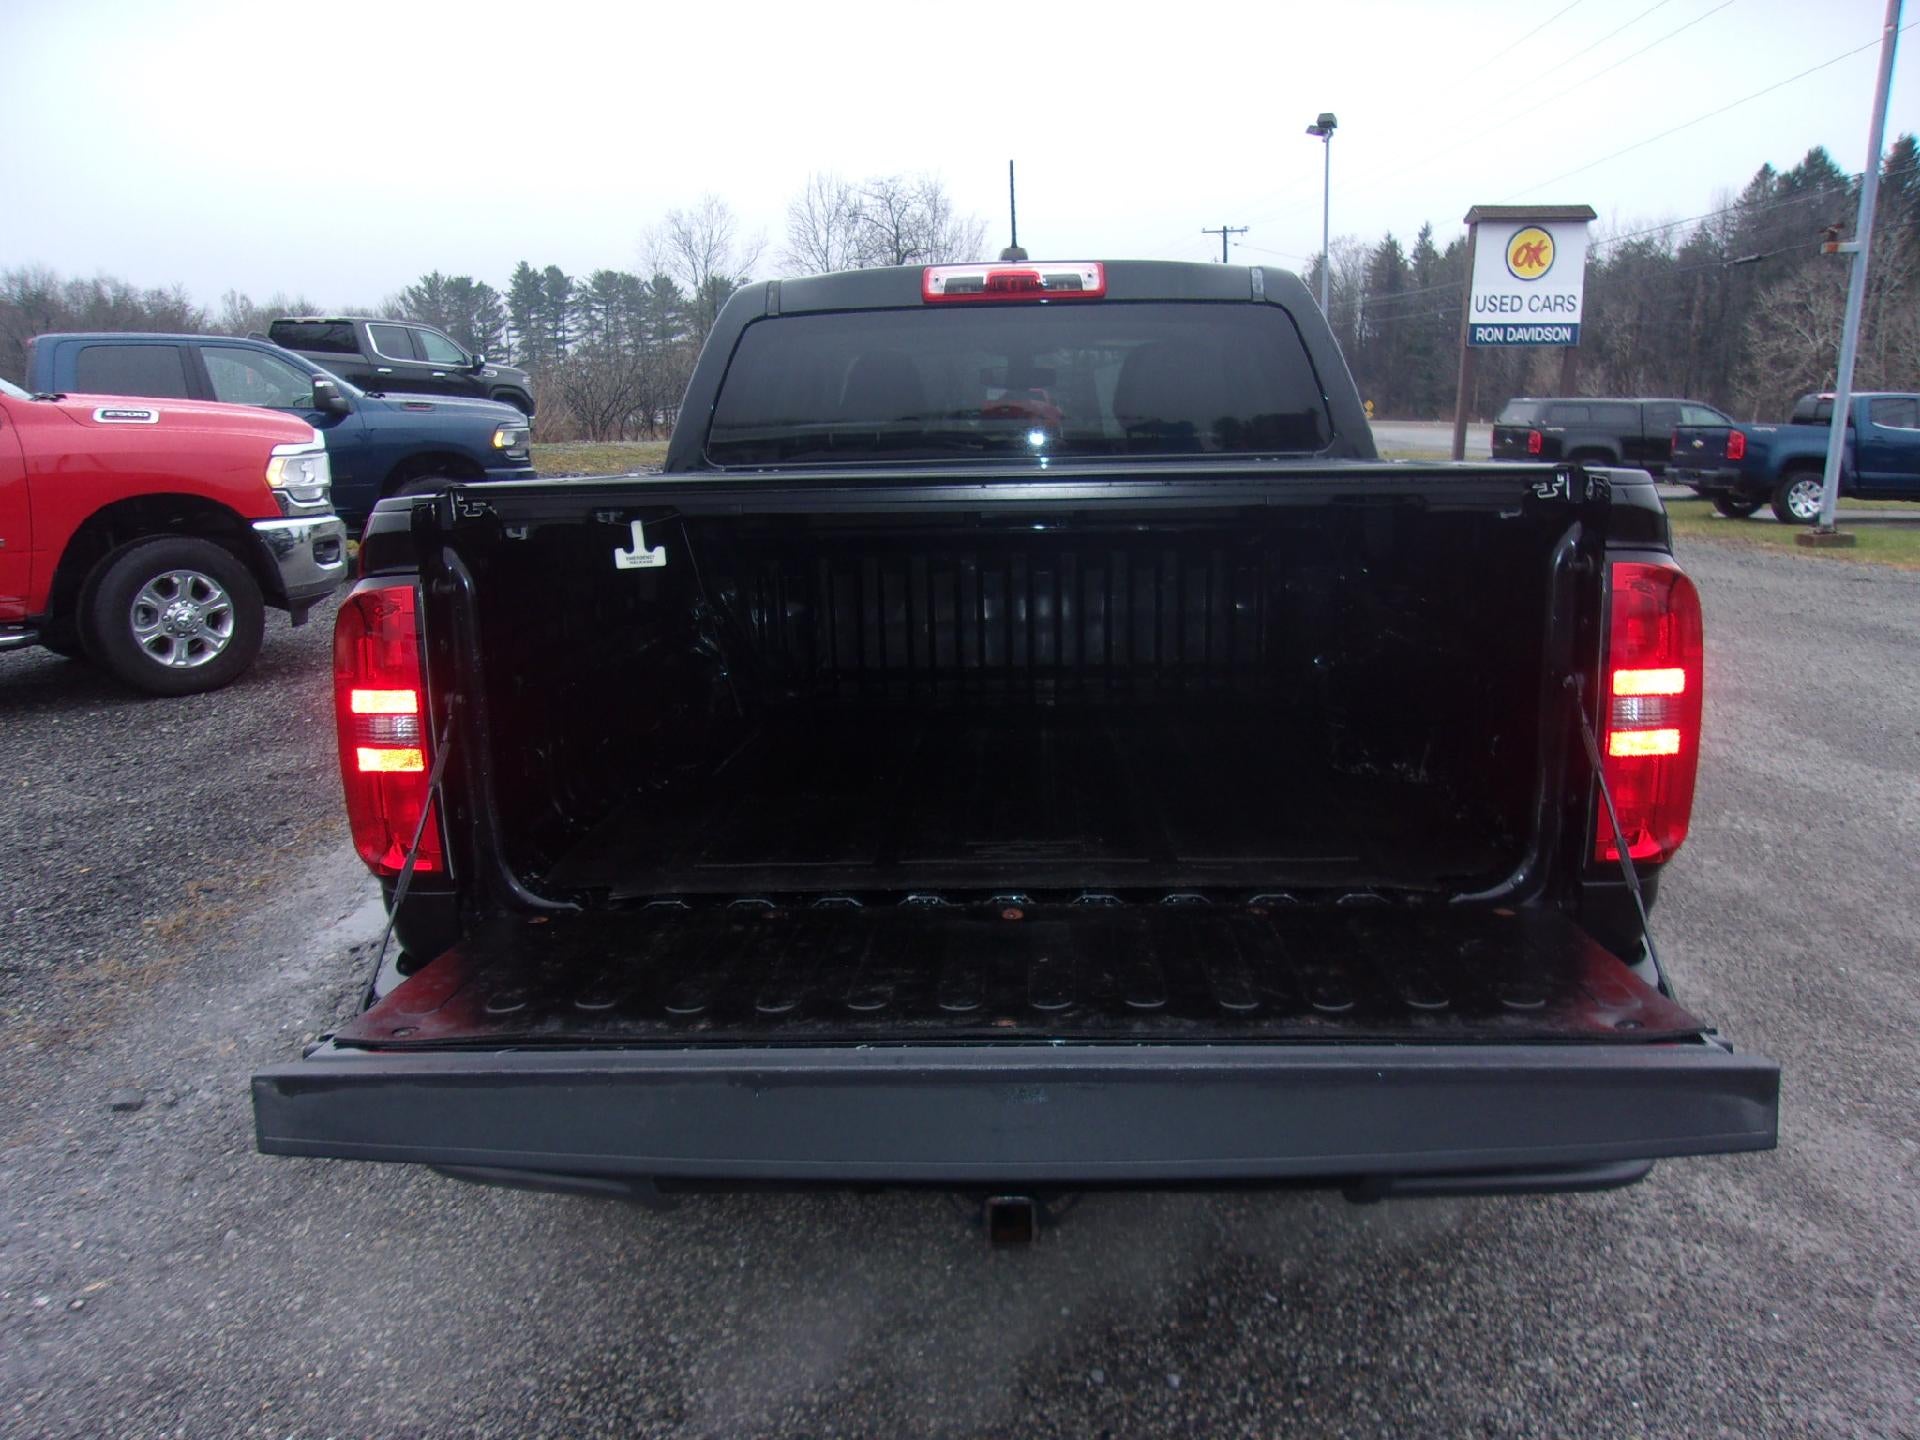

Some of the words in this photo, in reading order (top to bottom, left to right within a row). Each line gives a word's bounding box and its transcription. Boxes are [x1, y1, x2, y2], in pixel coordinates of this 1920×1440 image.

[1512, 240, 1548, 269] OK
[1475, 294, 1523, 313] USED
[1528, 294, 1577, 313] CARS
[1475, 327, 1504, 342] RON
[1506, 327, 1571, 341] DAVIDSON
